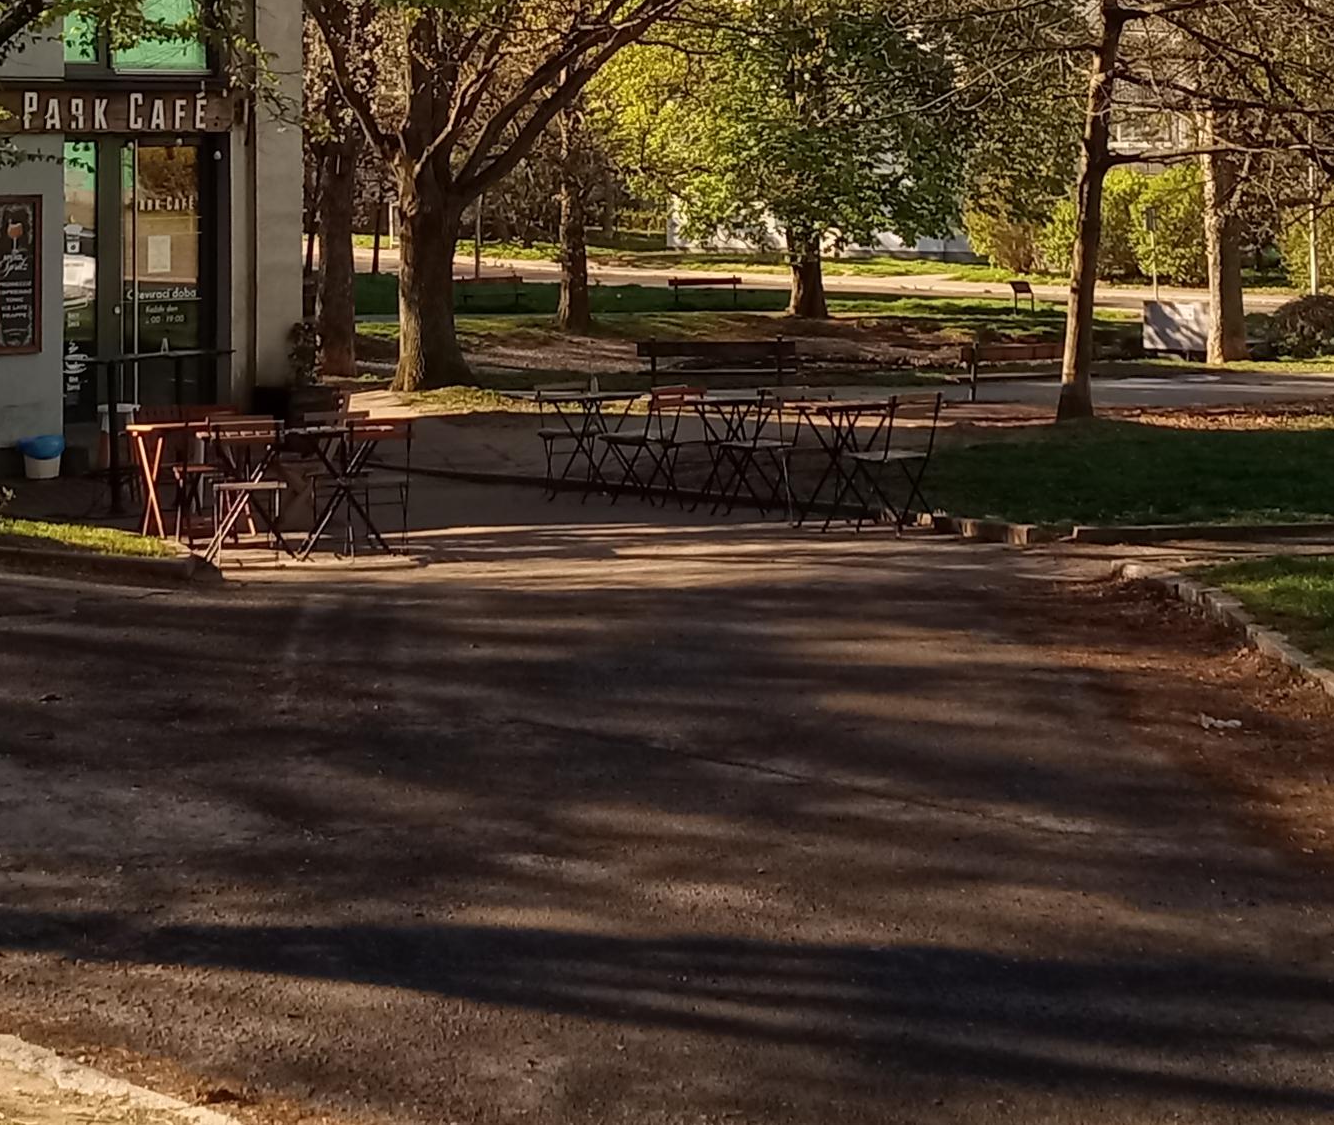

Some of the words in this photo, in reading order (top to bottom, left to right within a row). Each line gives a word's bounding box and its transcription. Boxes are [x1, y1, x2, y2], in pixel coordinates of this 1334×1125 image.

[23, 92, 108, 129] PARK
[129, 91, 207, 129] CAFÉ
[171, 286, 197, 298] doba
